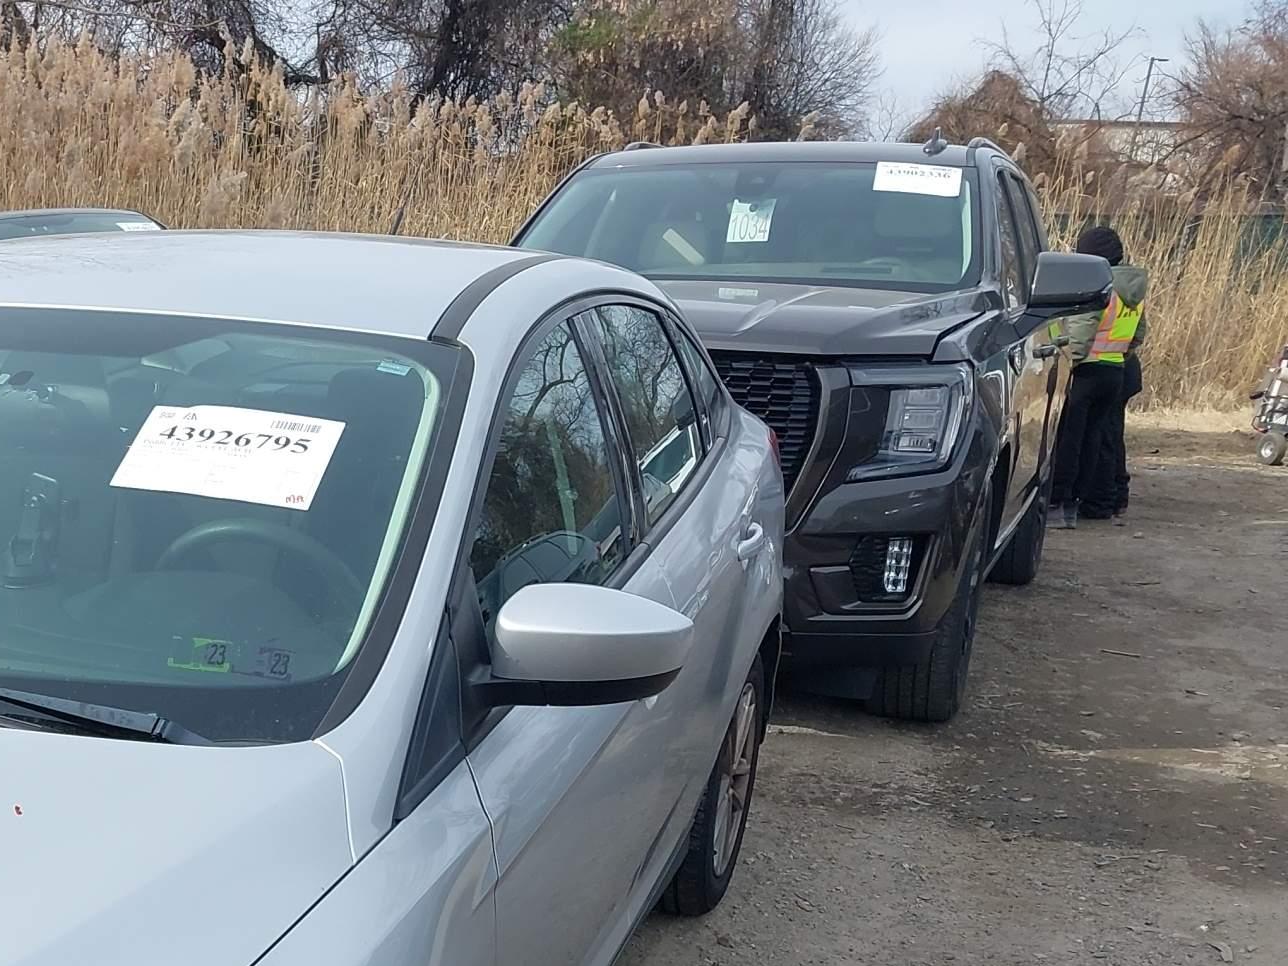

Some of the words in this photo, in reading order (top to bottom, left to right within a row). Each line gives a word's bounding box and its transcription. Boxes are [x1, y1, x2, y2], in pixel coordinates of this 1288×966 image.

[730, 213, 770, 241] 1034
[159, 424, 312, 454] 43926795
[207, 643, 227, 665] 23
[270, 652, 291, 676] 23
